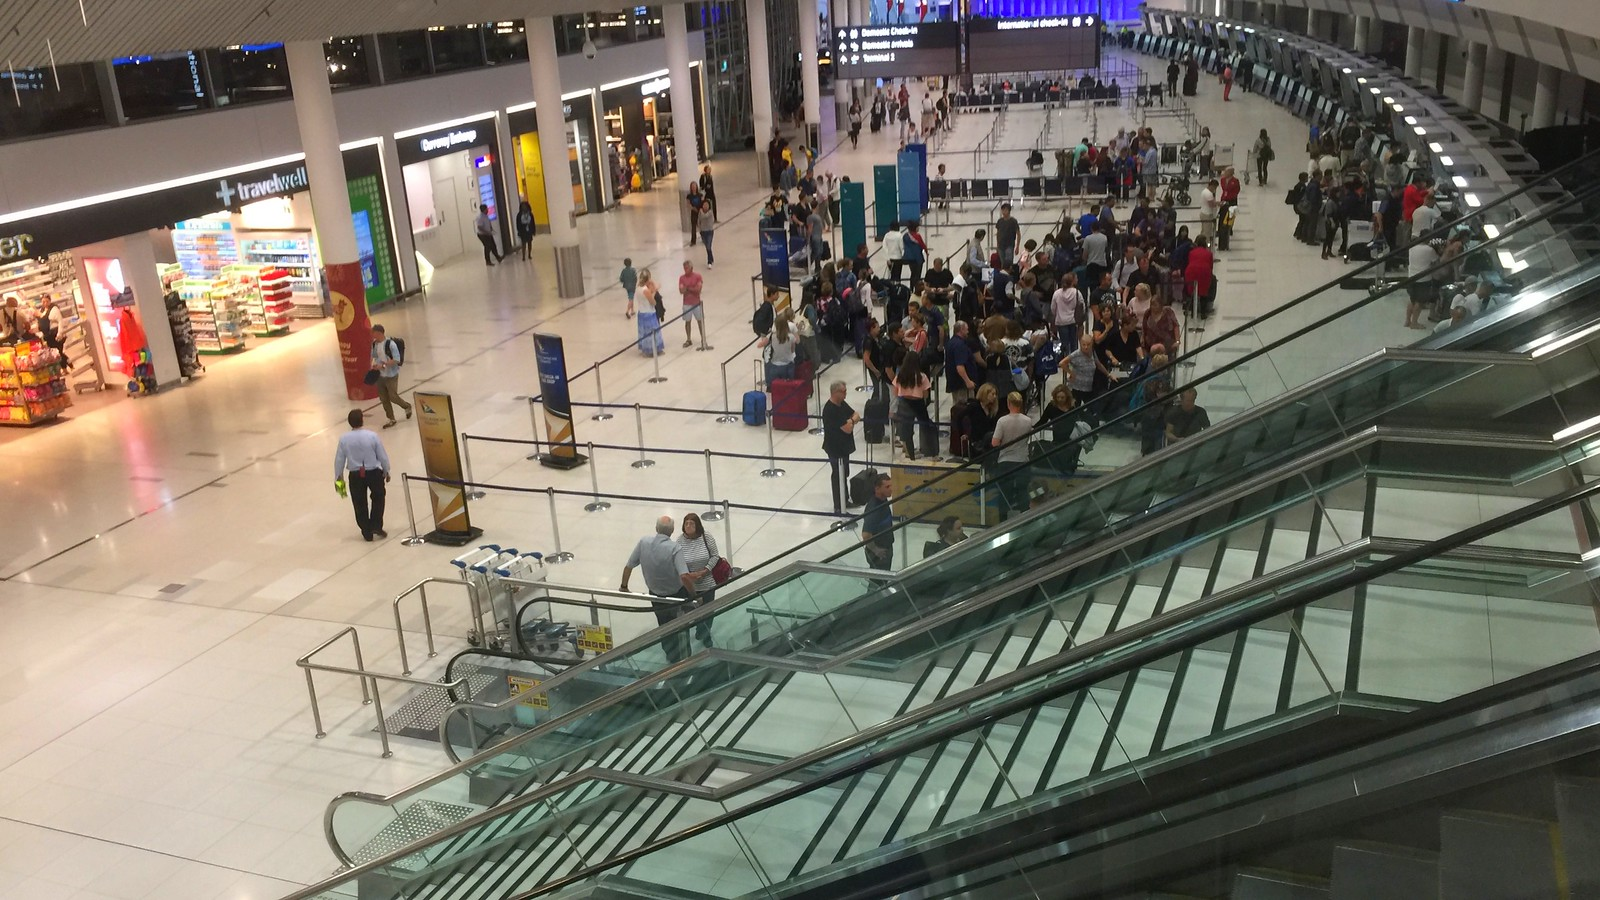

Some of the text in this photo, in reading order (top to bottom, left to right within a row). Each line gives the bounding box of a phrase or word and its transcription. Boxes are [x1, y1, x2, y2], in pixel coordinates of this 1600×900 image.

[997, 18, 1039, 30] International
[861, 27, 890, 37] Domestic
[862, 40, 890, 50] Domestic
[863, 52, 895, 62] Terminal 2
[420, 130, 477, 152] Currency Exchange
[237, 166, 307, 201] travelwell
